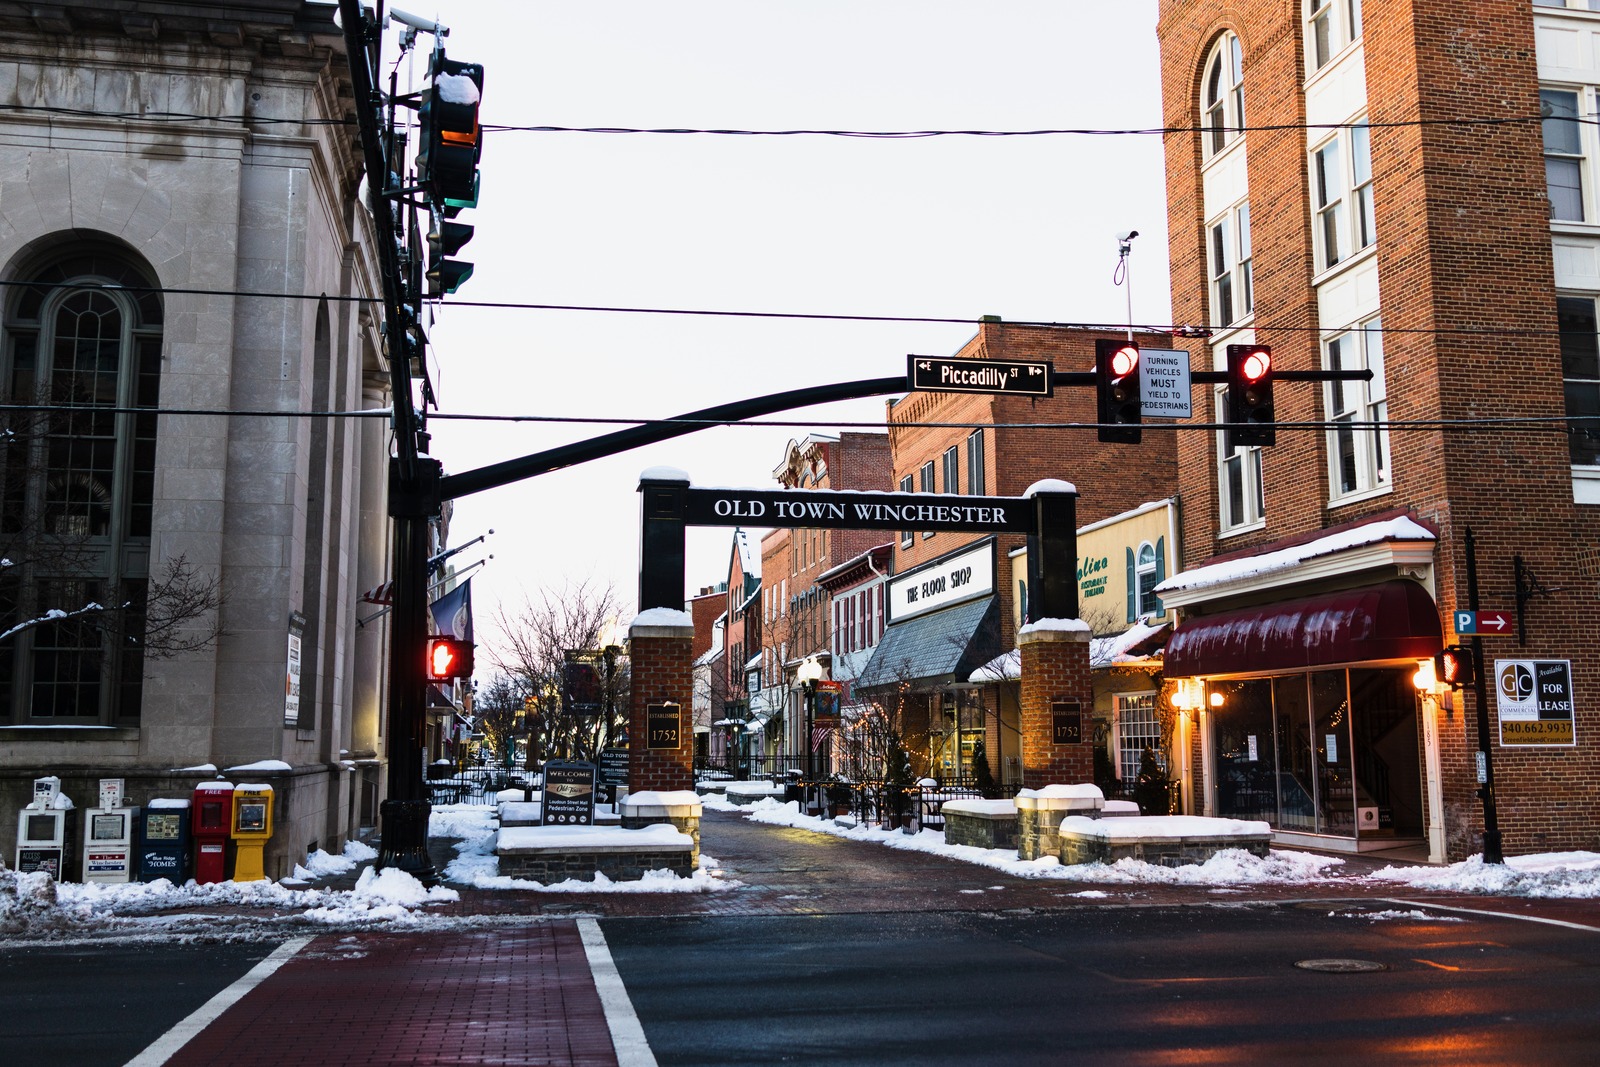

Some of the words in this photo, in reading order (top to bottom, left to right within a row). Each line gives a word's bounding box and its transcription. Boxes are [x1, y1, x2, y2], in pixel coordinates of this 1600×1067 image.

[1147, 357, 1179, 366] TURNING
[926, 361, 932, 371] E
[941, 365, 1007, 389] Piccadilly
[1010, 367, 1019, 378] ST
[1028, 366, 1035, 376] W
[1145, 368, 1181, 376] VEHICLES
[1151, 379, 1176, 388] MUST
[1147, 391, 1169, 399] YIELD
[1171, 391, 1181, 399] TO
[1140, 401, 1189, 410] PEDESTRIANS
[714, 499, 766, 517] OLD
[774, 501, 846, 519] TOWN
[853, 503, 1007, 524] WINCHESTER
[1076, 556, 1108, 581] olino
[907, 586, 918, 604] THE
[922, 576, 946, 598] FLOOR
[951, 566, 972, 589] SHOP
[1084, 586, 1105, 598] ITALIANO
[1458, 613, 1472, 632] P
[1538, 664, 1563, 678] Available
[1542, 683, 1564, 694] FOR
[1539, 701, 1571, 711] LEASE
[1057, 726, 1078, 738] 1752
[1502, 723, 1573, 734] 540.662.9937
[652, 729, 677, 742] 1752
[549, 770, 591, 778] WELCOME
